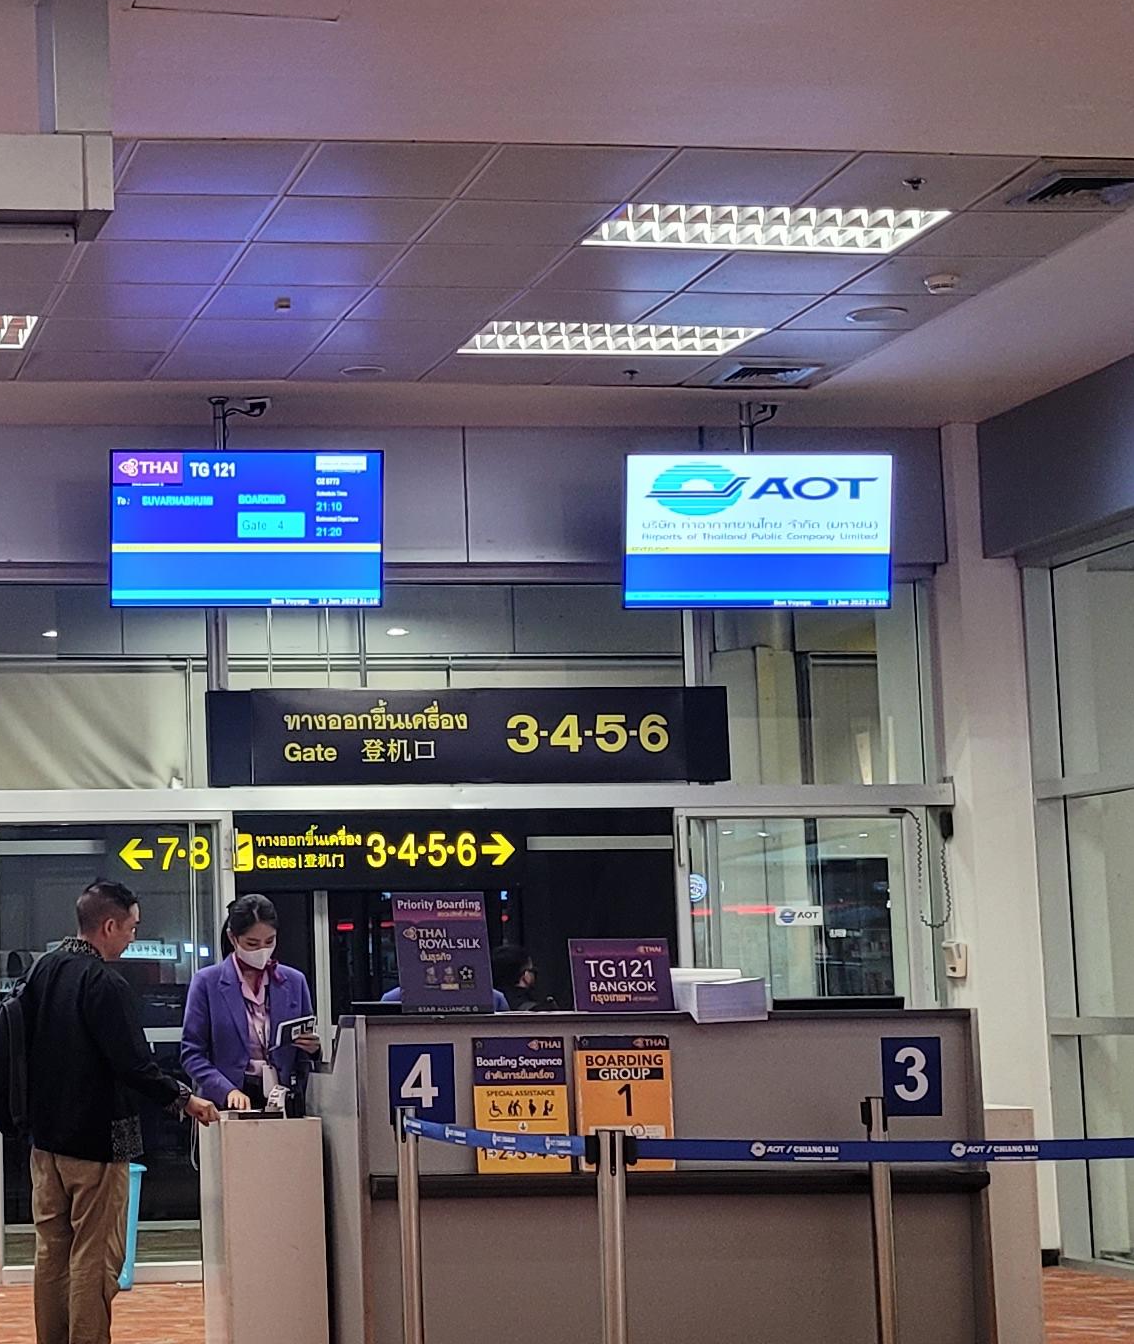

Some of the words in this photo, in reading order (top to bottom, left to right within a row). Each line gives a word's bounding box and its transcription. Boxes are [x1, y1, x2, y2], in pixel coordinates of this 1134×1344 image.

[139, 461, 179, 475] THAI
[190, 462, 210, 478] TG
[213, 462, 236, 478] 121
[748, 476, 878, 500] AOT
[238, 494, 286, 505] BOARDING
[316, 501, 342, 512] 21:10
[242, 520, 267, 531] Gate
[277, 520, 284, 530] 4
[316, 526, 342, 536] 21:20
[641, 532, 682, 542] Airports
[687, 532, 697, 540] of
[702, 532, 747, 540] Thailand
[751, 532, 783, 540] Public
[787, 532, 834, 542] Company
[840, 532, 878, 540] Limited
[283, 699, 468, 731] ทางออกขึ้นเครื่อง
[506, 713, 670, 754] 3-4-5-6
[284, 742, 338, 762] Gate
[361, 738, 436, 762] 登机口
[256, 824, 362, 847] ทางออกขึ้นเครื่อง
[256, 854, 297, 868] Gates
[397, 900, 434, 912] Priority
[436, 898, 481, 911] Boarding
[418, 928, 446, 938] THAI
[418, 938, 456, 949] ROYAL
[456, 938, 481, 948] SILK
[584, 960, 654, 978] TG121
[589, 981, 657, 992] BANGKOK
[540, 1040, 562, 1048] THAI
[645, 1038, 666, 1046] THAI
[476, 1056, 517, 1068] Boarding
[518, 1056, 563, 1068] Sequence
[585, 1054, 664, 1066] BOARDING
[598, 1068, 651, 1080] GROUP
[894, 1046, 929, 1102] 3
[400, 1054, 439, 1108] 4
[618, 1084, 632, 1116] 1
[482, 1148, 488, 1160] 1
[499, 1150, 508, 1160] 2
[766, 1145, 786, 1154] AOT
[794, 1145, 824, 1154] CHIANG
[824, 1145, 839, 1154] MAI
[966, 1145, 986, 1153] AOT
[993, 1145, 1024, 1153] CHIANG
[1024, 1144, 1038, 1152] MAI
